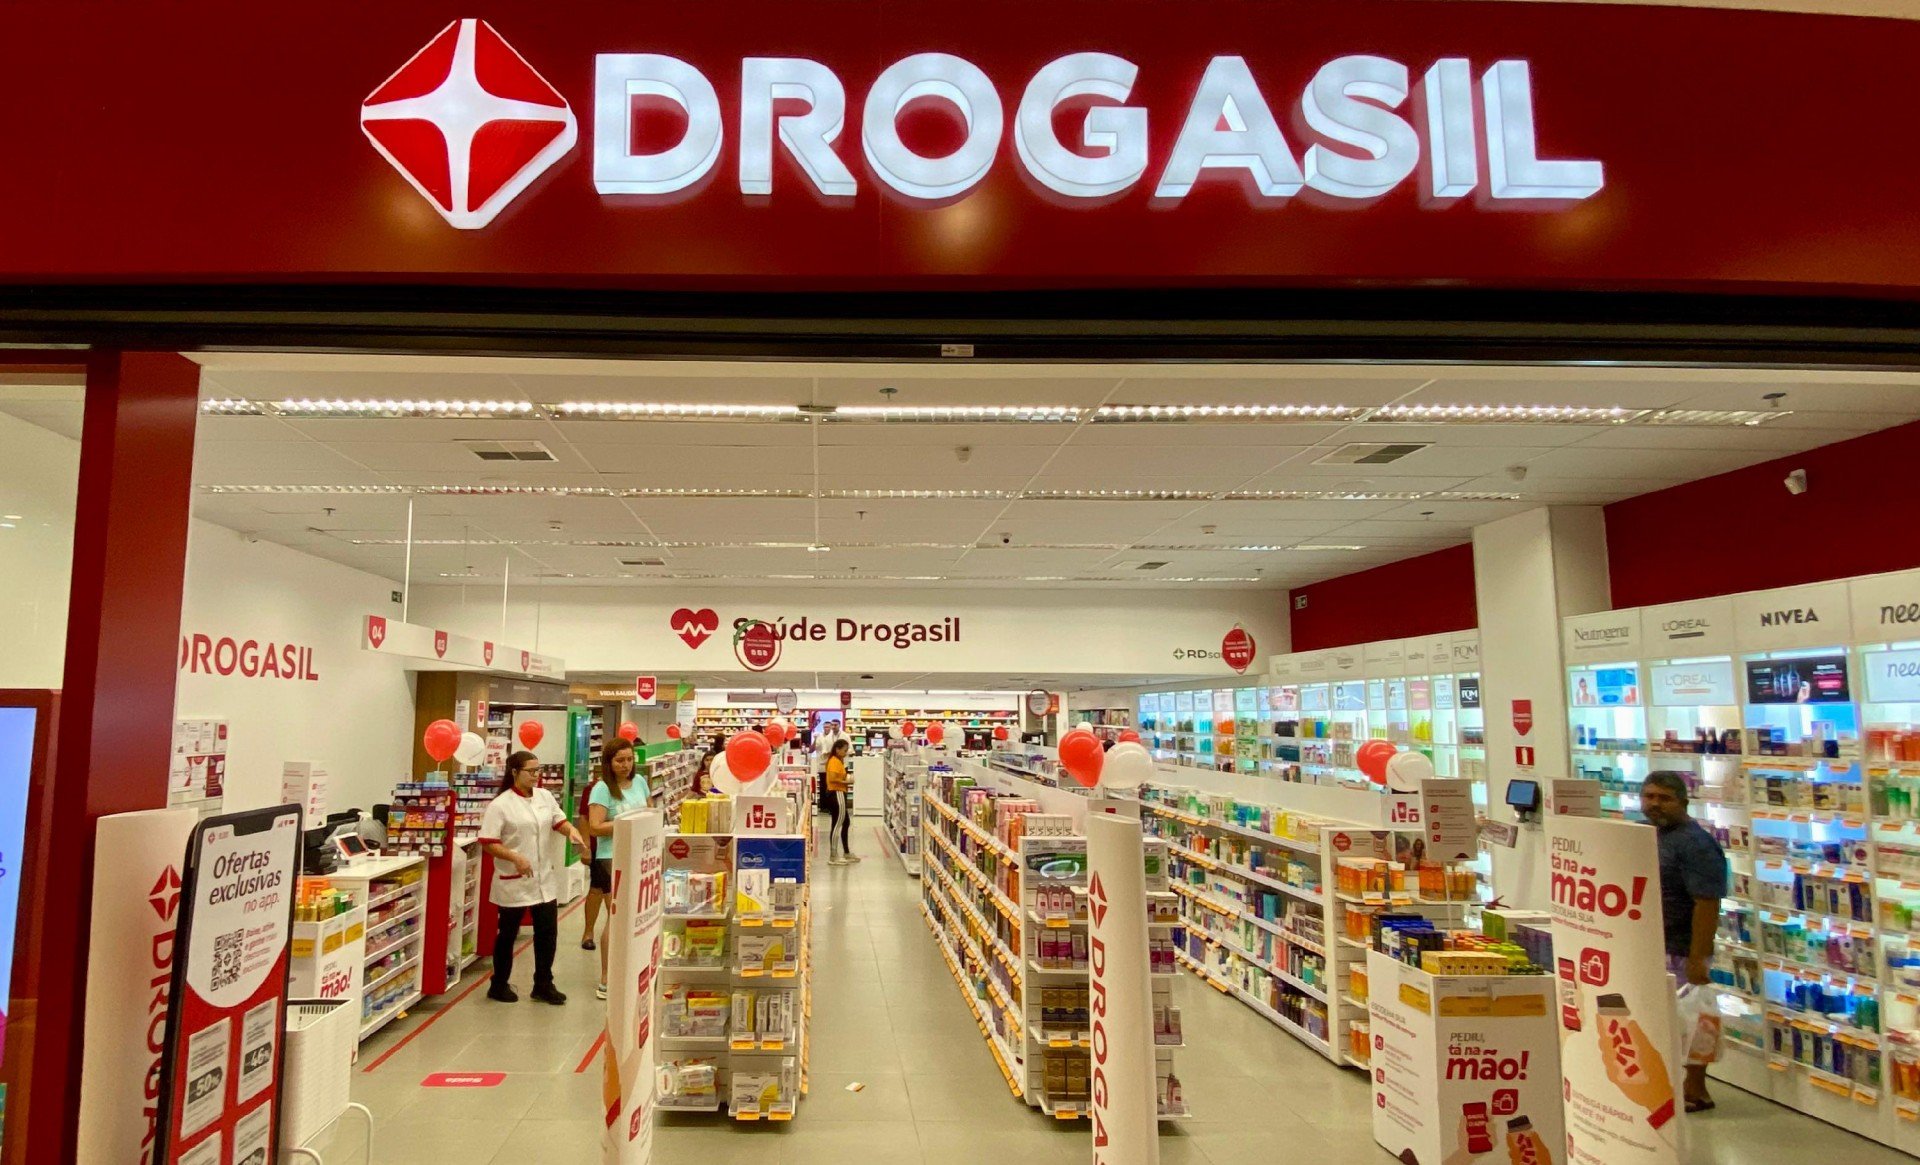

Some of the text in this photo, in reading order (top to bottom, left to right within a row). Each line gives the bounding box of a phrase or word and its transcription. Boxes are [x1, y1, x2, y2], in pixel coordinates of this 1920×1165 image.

[593, 51, 1604, 199] DROGASIL
[1760, 608, 1819, 627] NIVEA
[836, 616, 960, 649] Drogasil
[1574, 626, 1630, 642] Neutrogena
[213, 850, 271, 879] Ofertas
[1564, 859, 1578, 873] na
[208, 869, 282, 905] exclusivas
[1551, 866, 1649, 921] mão!
[243, 892, 280, 914] no app.
[1448, 1043, 1480, 1056] tá na
[1450, 1032, 1486, 1043] PEDIU,
[1445, 1048, 1530, 1081] mão!
